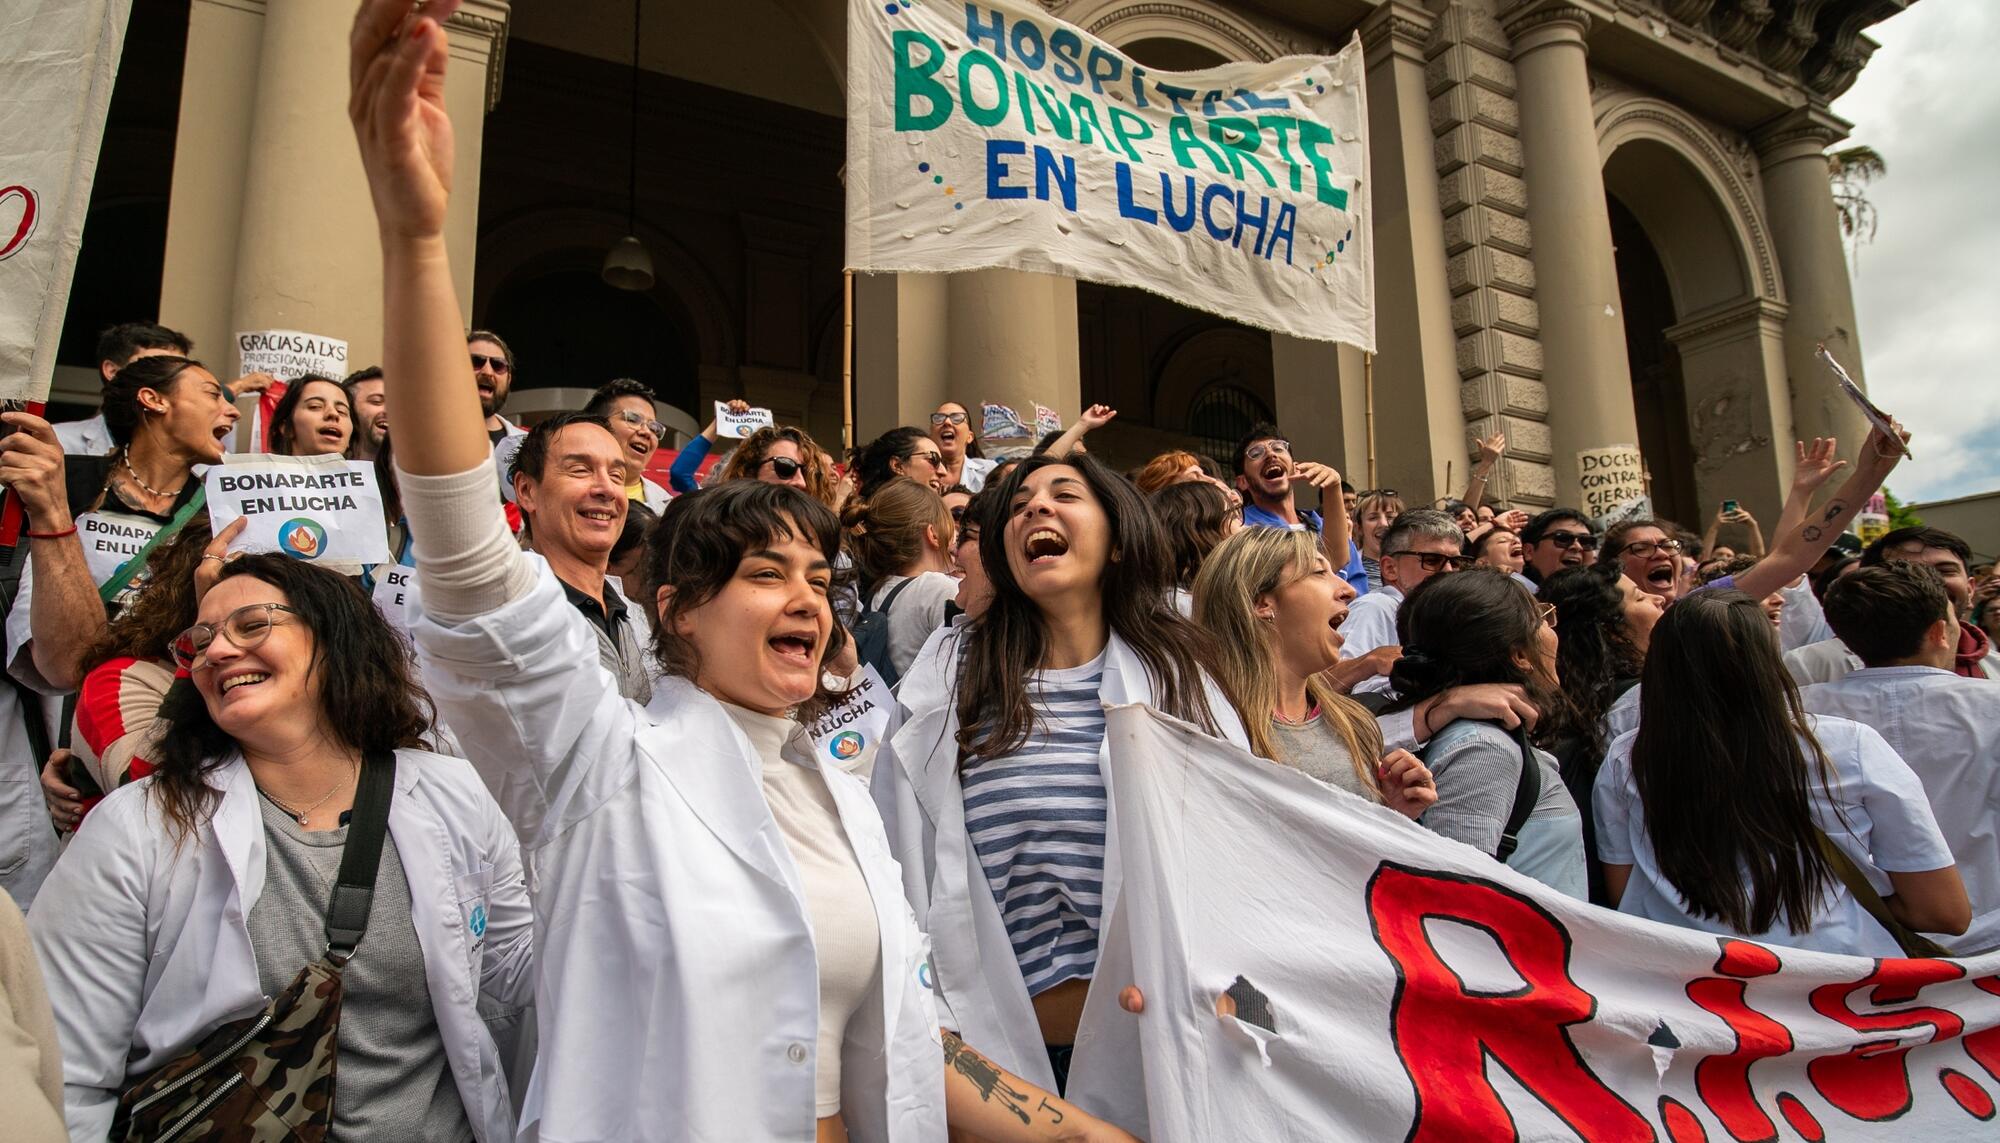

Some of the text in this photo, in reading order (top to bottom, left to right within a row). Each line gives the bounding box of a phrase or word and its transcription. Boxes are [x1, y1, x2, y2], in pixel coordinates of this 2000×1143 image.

[894, 30, 1349, 211] BONAPARTE
[986, 140, 1298, 265] EN LUCHA
[240, 335, 345, 362] GRACIAS A LXS
[243, 353, 325, 370] PROFESIONALES
[720, 407, 767, 418] BONAPARTE
[220, 472, 365, 492] BONAPARTE
[241, 495, 357, 515] EN LUCHA
[85, 520, 154, 541] BONAPA
[96, 539, 118, 553] EN
[821, 699, 875, 734] LUCHA
